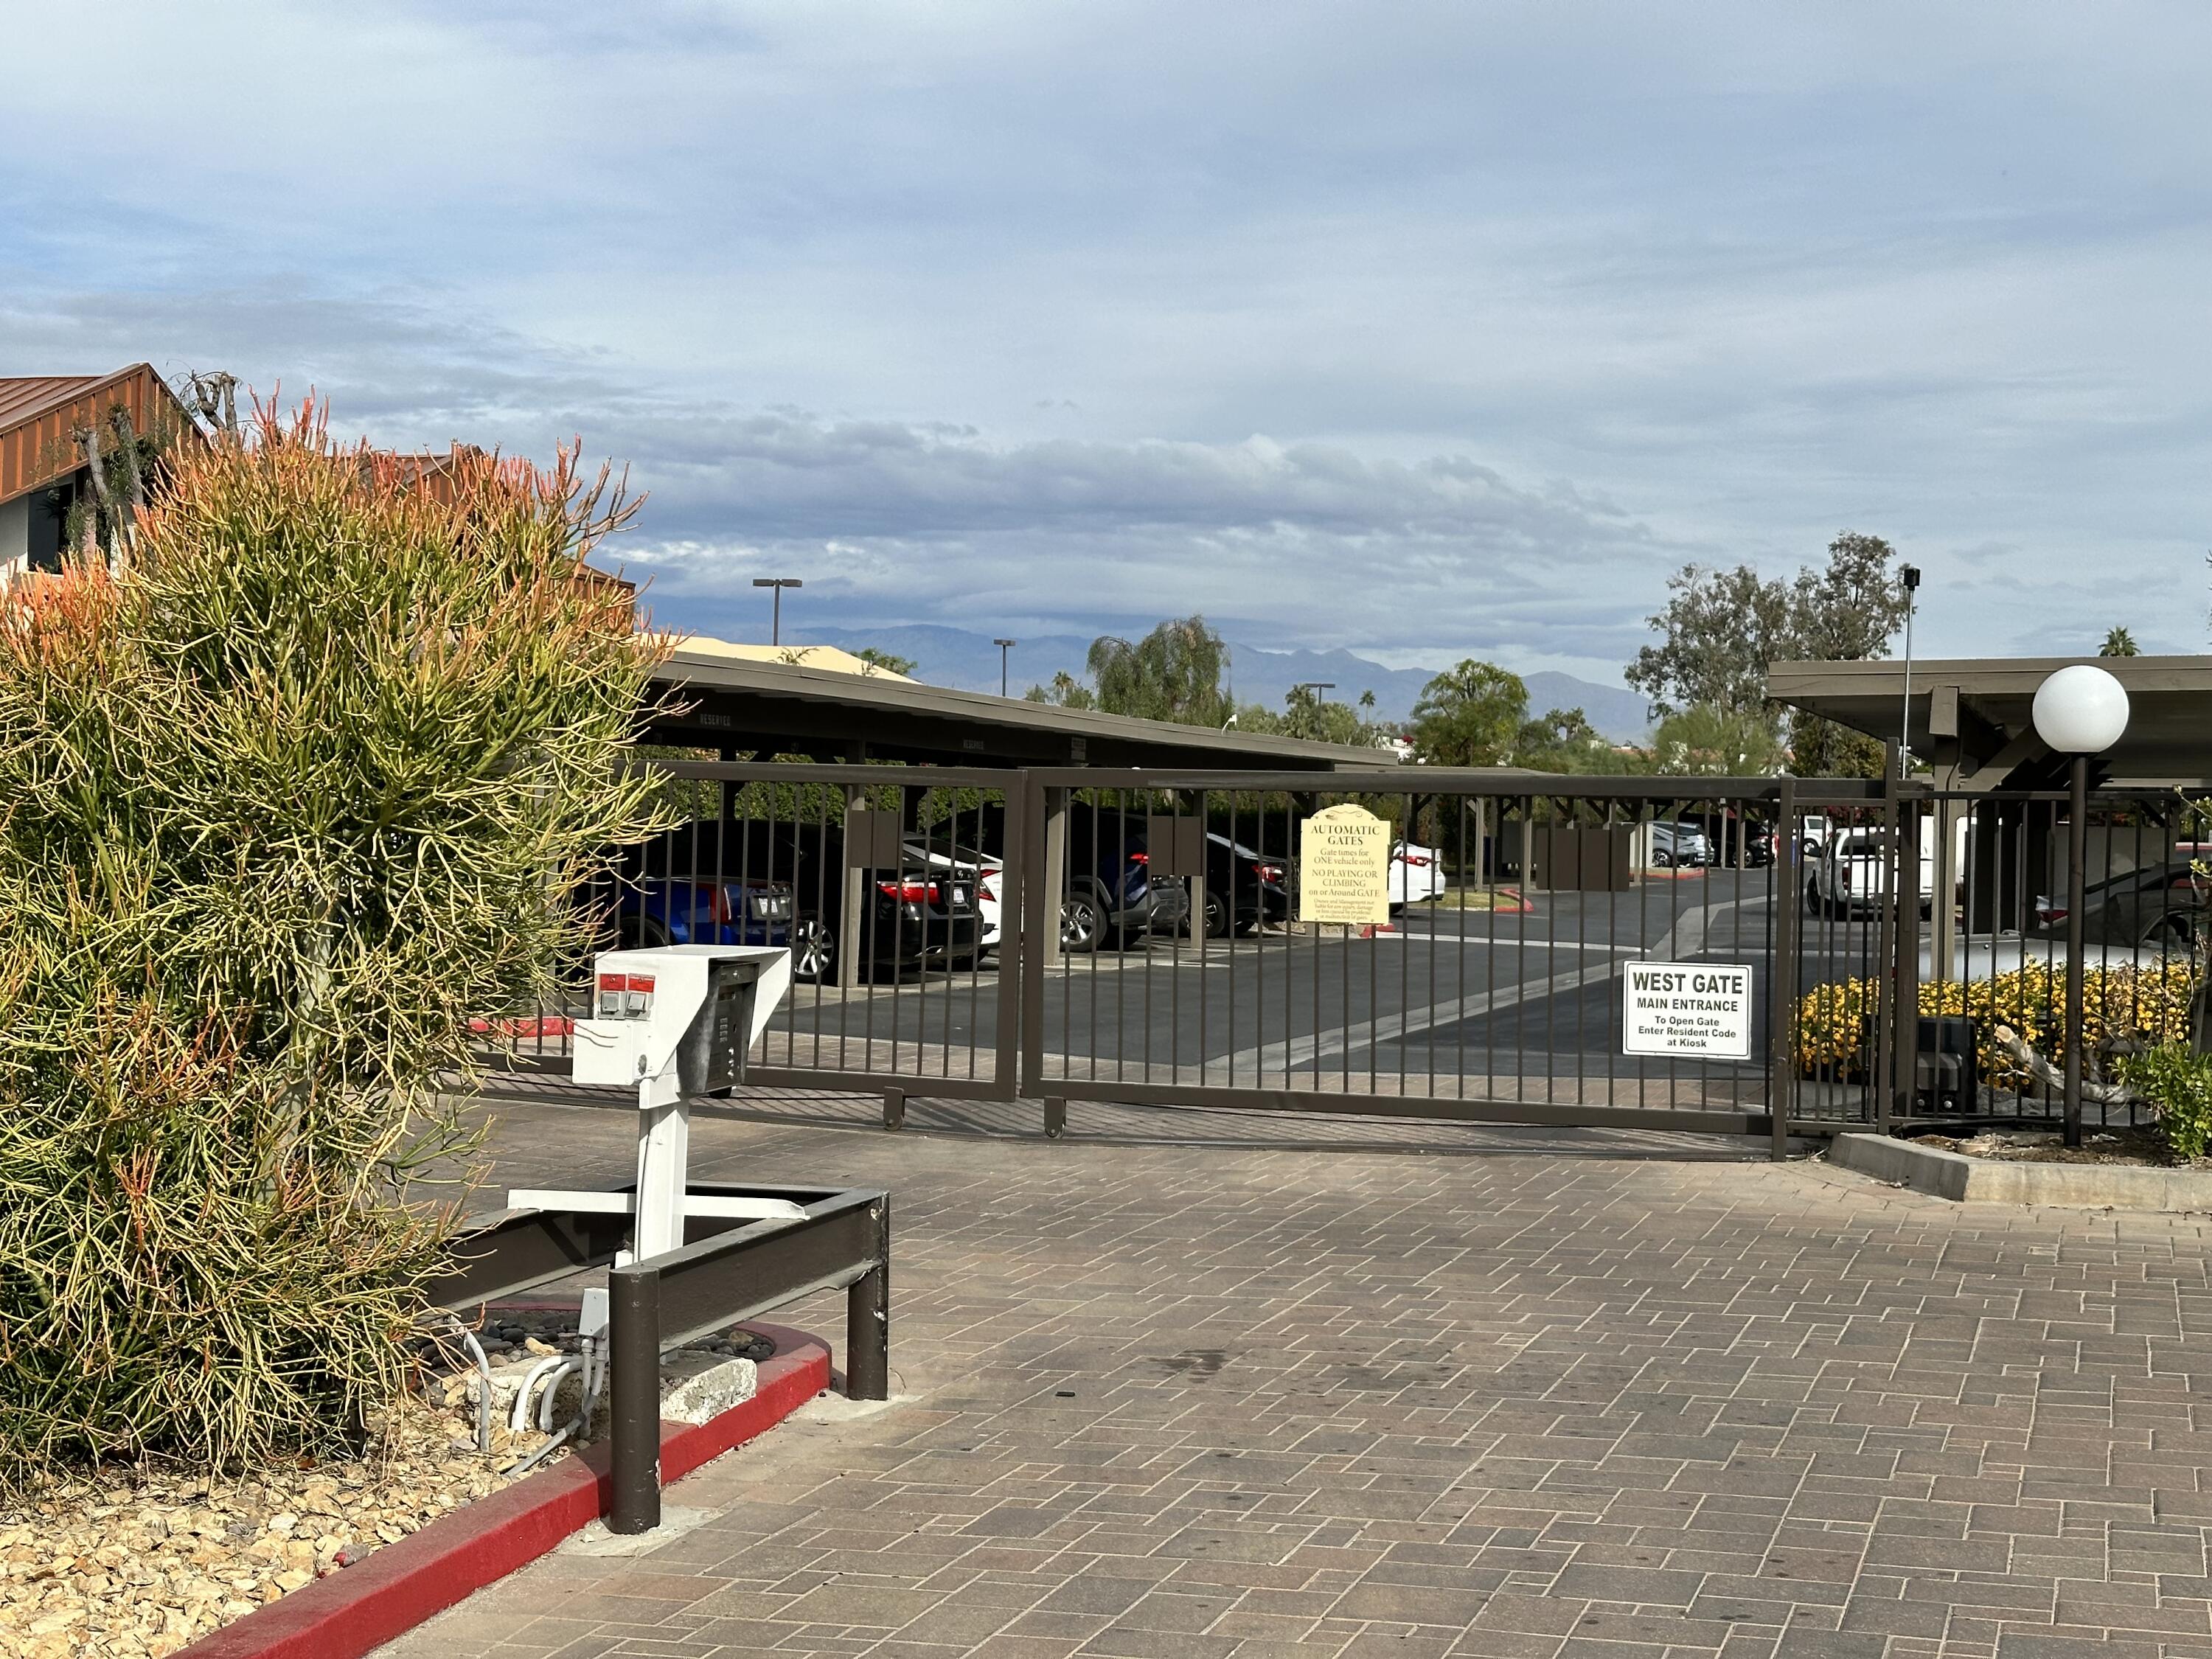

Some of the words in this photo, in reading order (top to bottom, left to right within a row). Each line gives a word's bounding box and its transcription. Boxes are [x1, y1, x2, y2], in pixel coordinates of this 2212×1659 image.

[1311, 825, 1380, 835] AUTOMATIC
[1328, 836, 1363, 845] GATES
[1360, 858, 1375, 866] only
[1323, 879, 1366, 887] CLIMBING
[1633, 972, 1686, 992] WEST
[1692, 974, 1742, 994] GATE
[1637, 997, 1668, 1009] MAIN
[1672, 998, 1738, 1012] ENTRANCE
[1655, 1016, 1666, 1024] To
[1669, 1016, 1694, 1027] Open
[1697, 1017, 1720, 1026] Gate
[1638, 1026, 1664, 1035] Enter
[1667, 1027, 1709, 1037] Resident
[1712, 1029, 1736, 1038] Code
[1680, 1038, 1706, 1047] Kiosk
